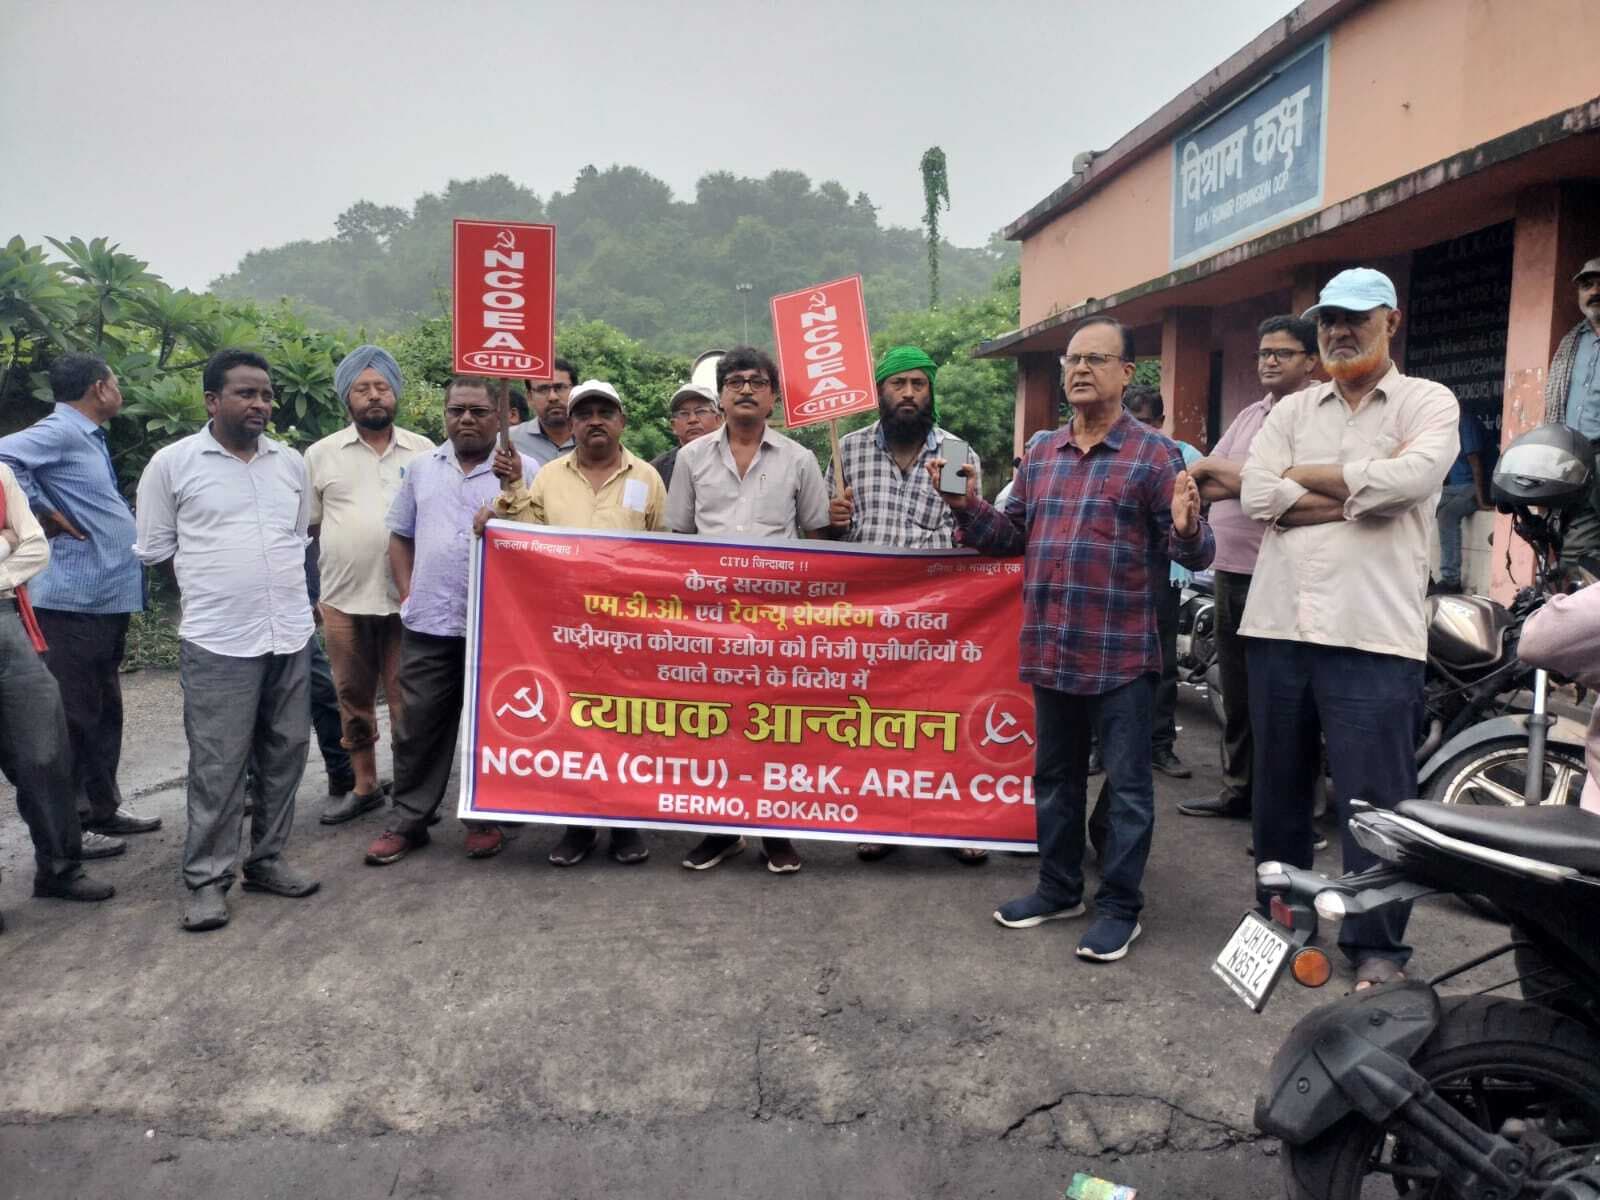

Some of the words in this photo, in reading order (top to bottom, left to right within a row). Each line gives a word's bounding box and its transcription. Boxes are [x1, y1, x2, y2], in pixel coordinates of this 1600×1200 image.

[1181, 125, 1248, 208] विश्राम
[1253, 84, 1311, 170] कक्ष
[482, 249, 525, 350] NCOEA
[473, 353, 532, 369] CITU
[800, 305, 848, 397] NCOEA
[803, 392, 856, 414] CITU
[720, 556, 749, 568] CITU
[684, 569, 728, 593] केन्द्र
[732, 577, 801, 595] सरकार
[807, 580, 847, 598] द्वारा
[584, 592, 688, 621] एम.डी.ओ.
[696, 603, 724, 623] एवं
[729, 599, 788, 631] रेवन्यू
[880, 605, 901, 629] के
[905, 611, 948, 630] तहत
[552, 623, 642, 654] राष्ट्रीयकृत
[648, 629, 713, 654] कोयला
[719, 634, 774, 657] उद्योग
[780, 636, 807, 658] को
[811, 636, 858, 660] निजी
[960, 640, 983, 663] के
[657, 662, 708, 683] हवाले
[712, 665, 762, 686] करने
[766, 666, 787, 687] के
[792, 666, 847, 689] विरोध
[851, 669, 870, 690] में
[568, 692, 732, 739] व्यापक
[743, 695, 960, 752] आन्दोलन
[481, 745, 608, 782] NCOEA
[617, 752, 729, 789] (CITU)
[762, 762, 850, 795] B&K.
[858, 767, 961, 801] AREA
[658, 793, 750, 820] BERMO,
[756, 798, 858, 822] BOKARO
[1244, 925, 1282, 964] JH10C
